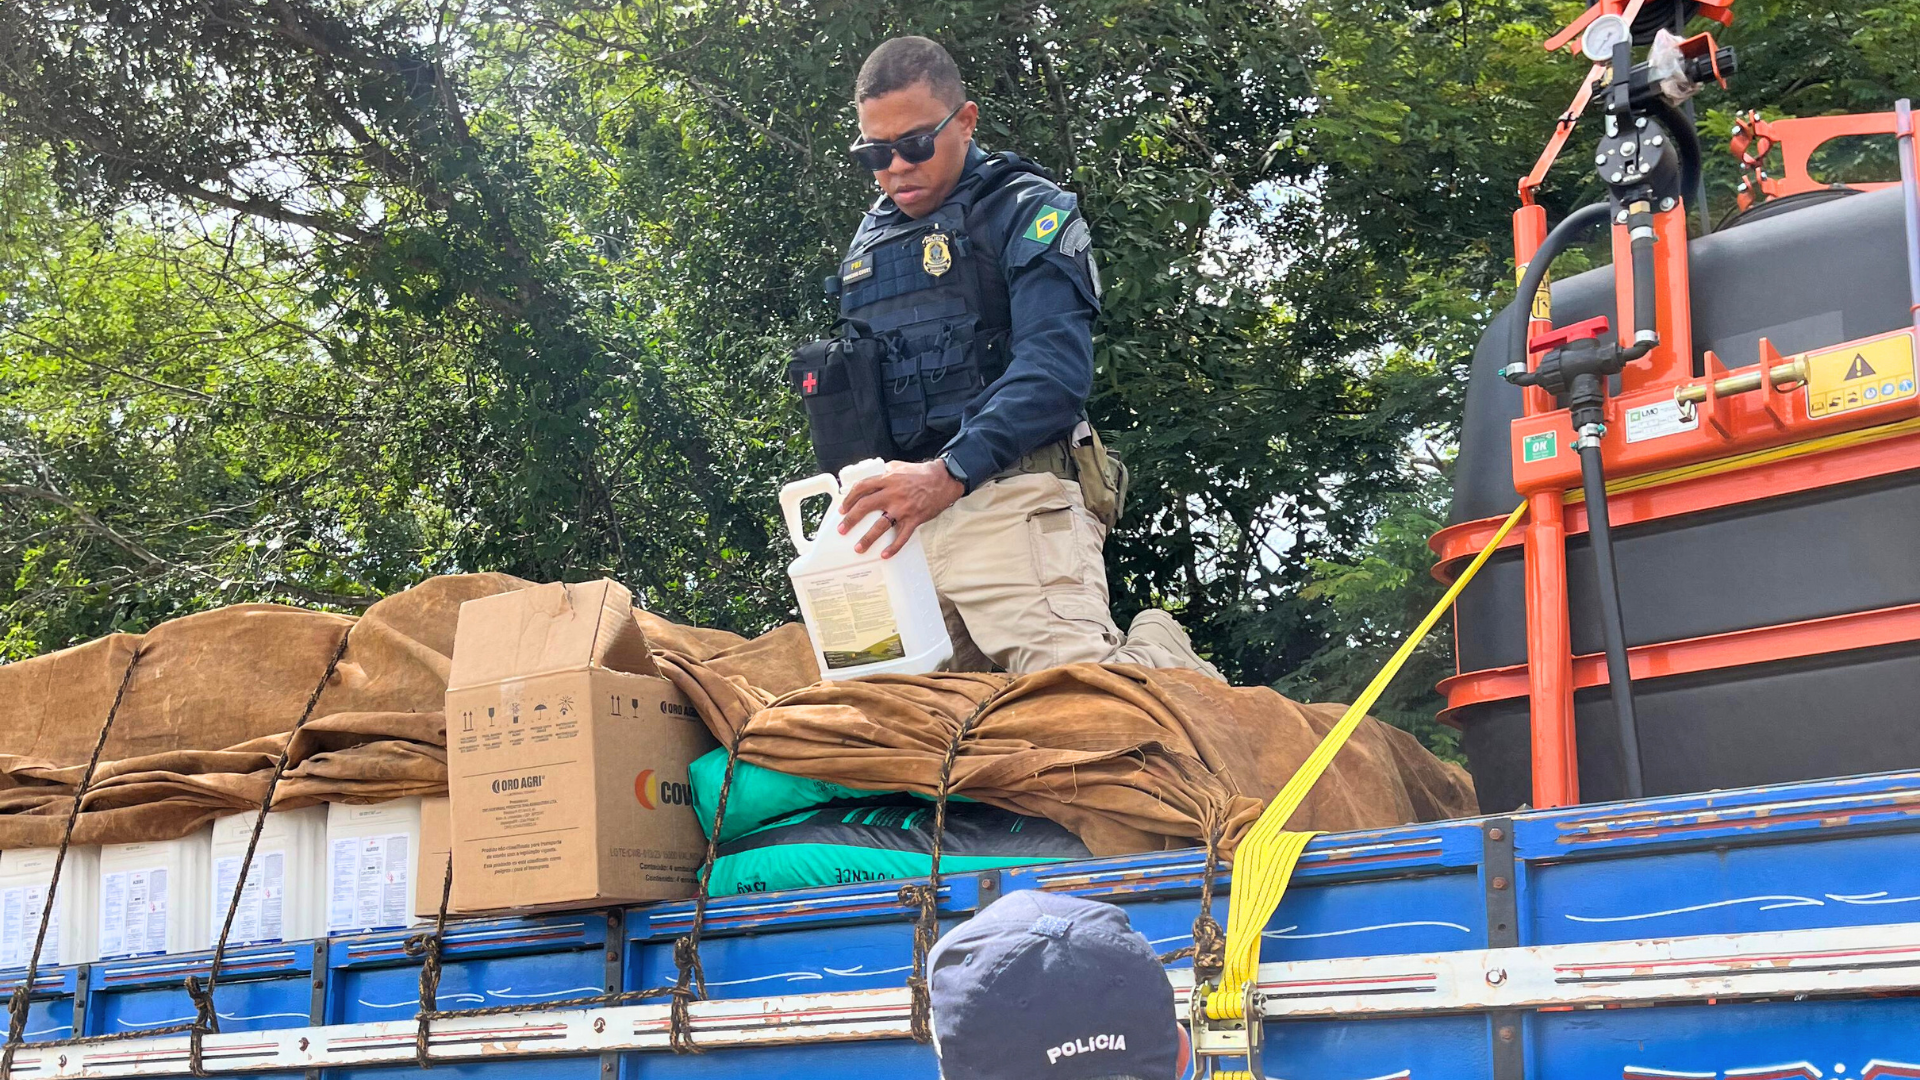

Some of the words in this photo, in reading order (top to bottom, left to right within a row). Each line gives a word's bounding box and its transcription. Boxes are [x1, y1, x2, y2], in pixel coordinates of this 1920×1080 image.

[1532, 440, 1547, 452] OK
[668, 703, 682, 715] ORO
[501, 778, 519, 792] ORO
[521, 775, 542, 789] AGRI
[1046, 1034, 1127, 1065] POLÍCIA
